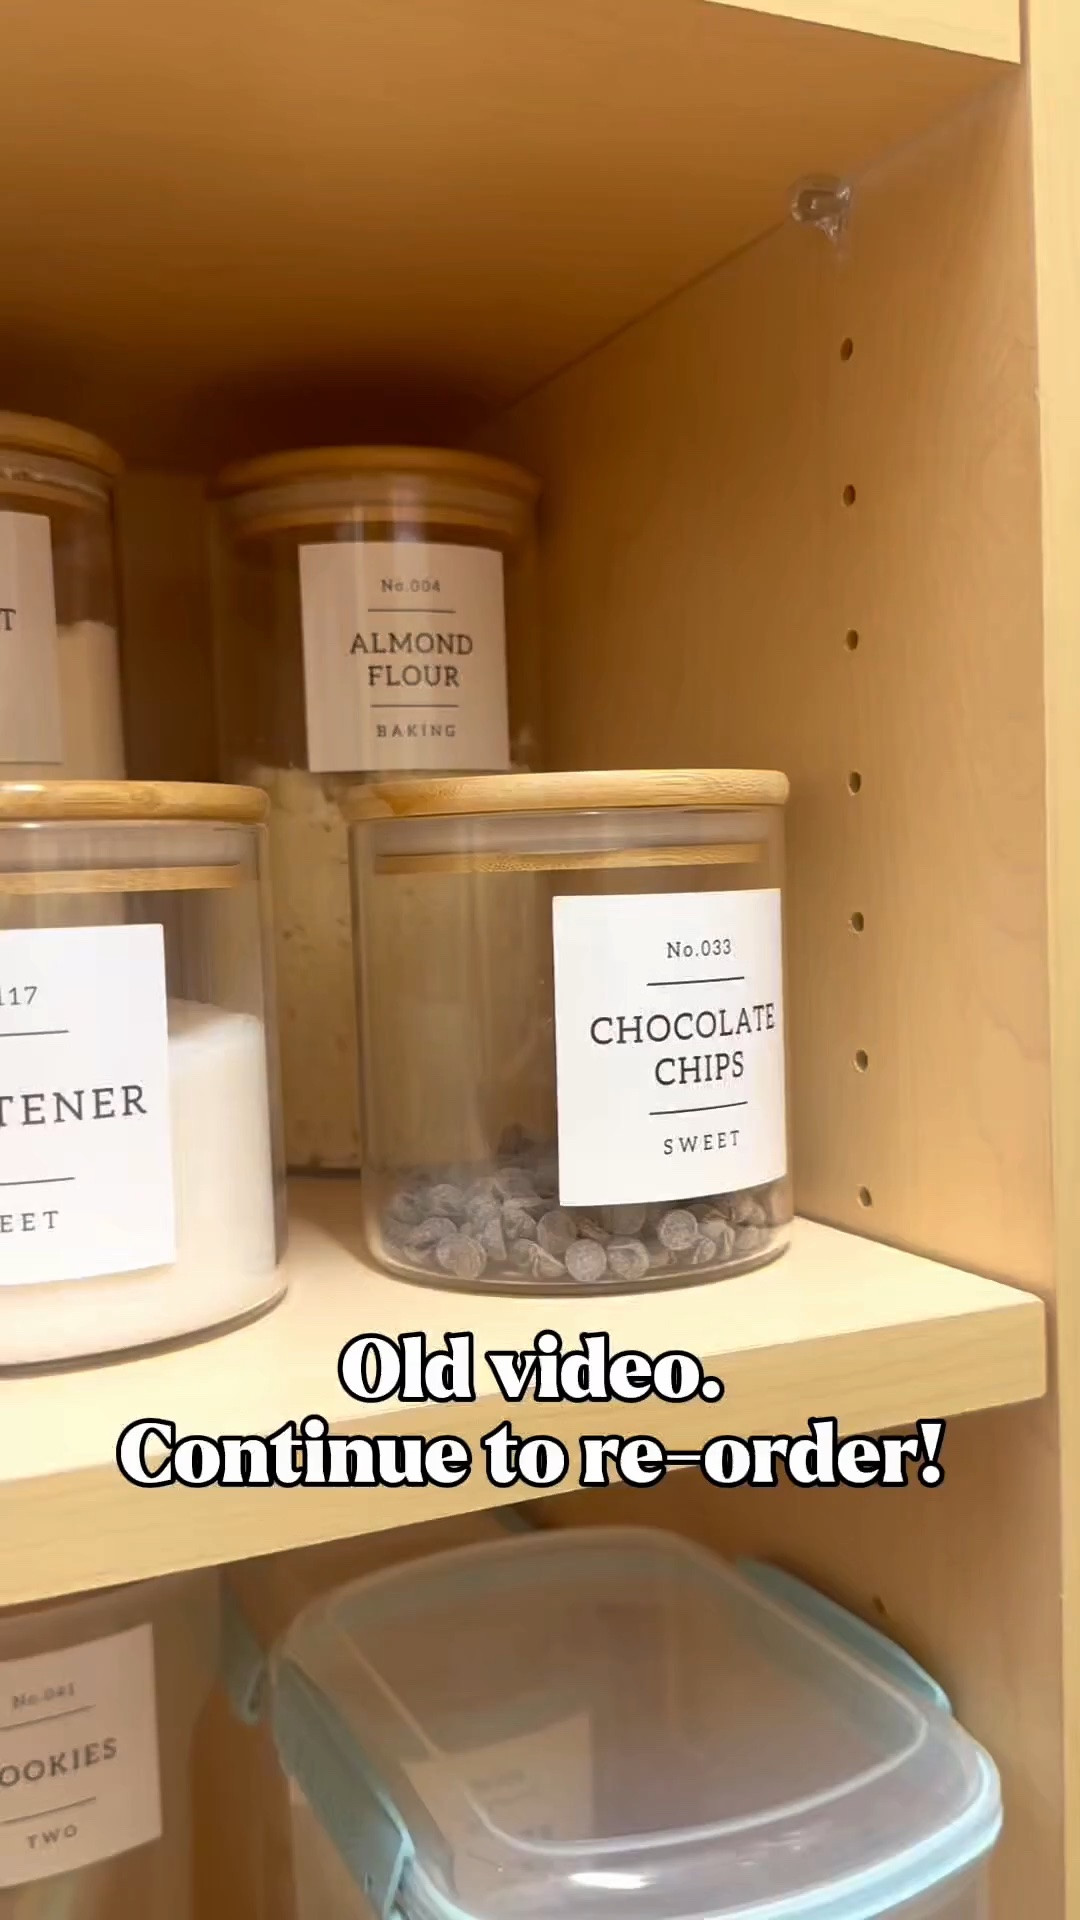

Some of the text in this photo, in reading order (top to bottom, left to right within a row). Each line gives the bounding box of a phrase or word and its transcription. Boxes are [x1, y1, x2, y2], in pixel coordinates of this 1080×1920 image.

[381, 578, 441, 593] No.004
[350, 632, 474, 656] ALMOND
[368, 665, 460, 687] FLOUR
[376, 723, 456, 738] BAKING
[666, 938, 733, 959] No.033
[590, 1002, 775, 1045] CHOCOLATE
[655, 1051, 745, 1086] CHIPS
[663, 1130, 741, 1155] SWEET
[0, 1737, 118, 1787] OOKIES
[26, 1824, 78, 1850] TWO
